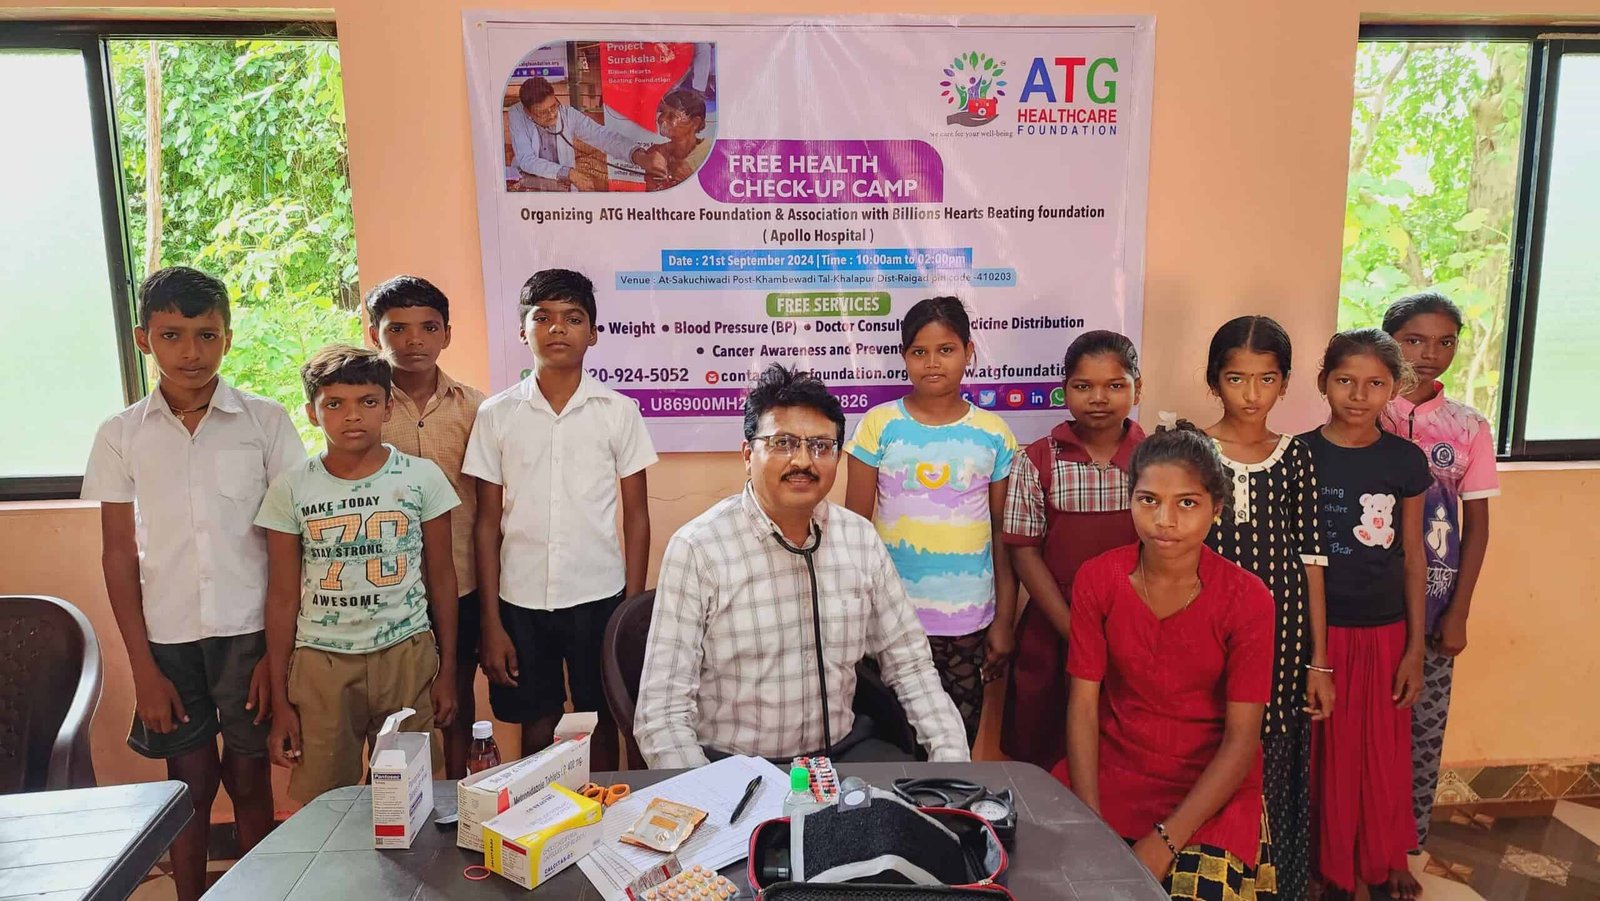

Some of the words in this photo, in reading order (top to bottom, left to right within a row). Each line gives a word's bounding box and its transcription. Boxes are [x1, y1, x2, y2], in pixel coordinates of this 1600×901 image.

[607, 42, 644, 52] Project
[608, 54, 656, 65] Suraksha
[1019, 57, 1119, 104] ATG
[1018, 108, 1117, 123] HEALTHCARE
[981, 130, 1013, 138] well-being
[1018, 124, 1117, 136] FOUNDATION
[729, 155, 782, 173] FREE
[789, 155, 878, 173] HEALTH
[729, 179, 846, 198] CHECK-UP
[852, 179, 918, 198] CAMP
[520, 207, 593, 224] Organizing
[600, 208, 623, 221] ATG
[627, 207, 696, 221] Healthcare
[699, 207, 772, 221] Foundation
[775, 208, 784, 221] &
[788, 207, 858, 221] Association
[862, 207, 889, 220] with
[892, 207, 940, 220] Billions
[944, 207, 984, 220] Hearts
[987, 206, 1035, 222] Beating
[1038, 206, 1105, 219] foundation
[770, 229, 811, 245] Apollo
[814, 228, 866, 245] Hospital
[669, 255, 693, 266] Date
[702, 255, 726, 266] 21st
[727, 255, 785, 269] September
[787, 255, 814, 266] 2024
[821, 254, 847, 265] Time
[856, 254, 902, 265] 10:00am
[905, 255, 915, 265] to
[917, 254, 966, 268] 02:00pm
[620, 276, 650, 284] Venue
[658, 275, 730, 284] At-Sakuchiwadi
[733, 274, 816, 284] Post-Khambewadi
[818, 274, 874, 285] Tal-Khalapur
[877, 273, 929, 284] Dist-Raigad
[948, 273, 971, 282] code
[973, 272, 1012, 281] -410203
[777, 298, 810, 313] FREE
[814, 297, 880, 312] SERVICES
[609, 322, 655, 337] Weight
[674, 321, 710, 334] Blood
[714, 321, 768, 334] Pressure
[771, 320, 797, 335] (BP)
[815, 320, 855, 333] Doctor
[858, 319, 904, 331] Consult
[971, 317, 1008, 330] dicine
[1012, 316, 1084, 330] Distribution
[713, 345, 754, 357] Cancer
[760, 344, 827, 356] Awareness
[829, 343, 851, 355] and
[856, 343, 903, 355] Prevent
[588, 367, 689, 382] 20-924-5052
[965, 363, 1066, 380] w.atgfoundatio
[301, 501, 334, 517] MAKE
[341, 496, 380, 509] TODAY
[311, 548, 332, 559] STAY
[336, 543, 383, 558] STRONG
[312, 593, 381, 607] AWESOME
